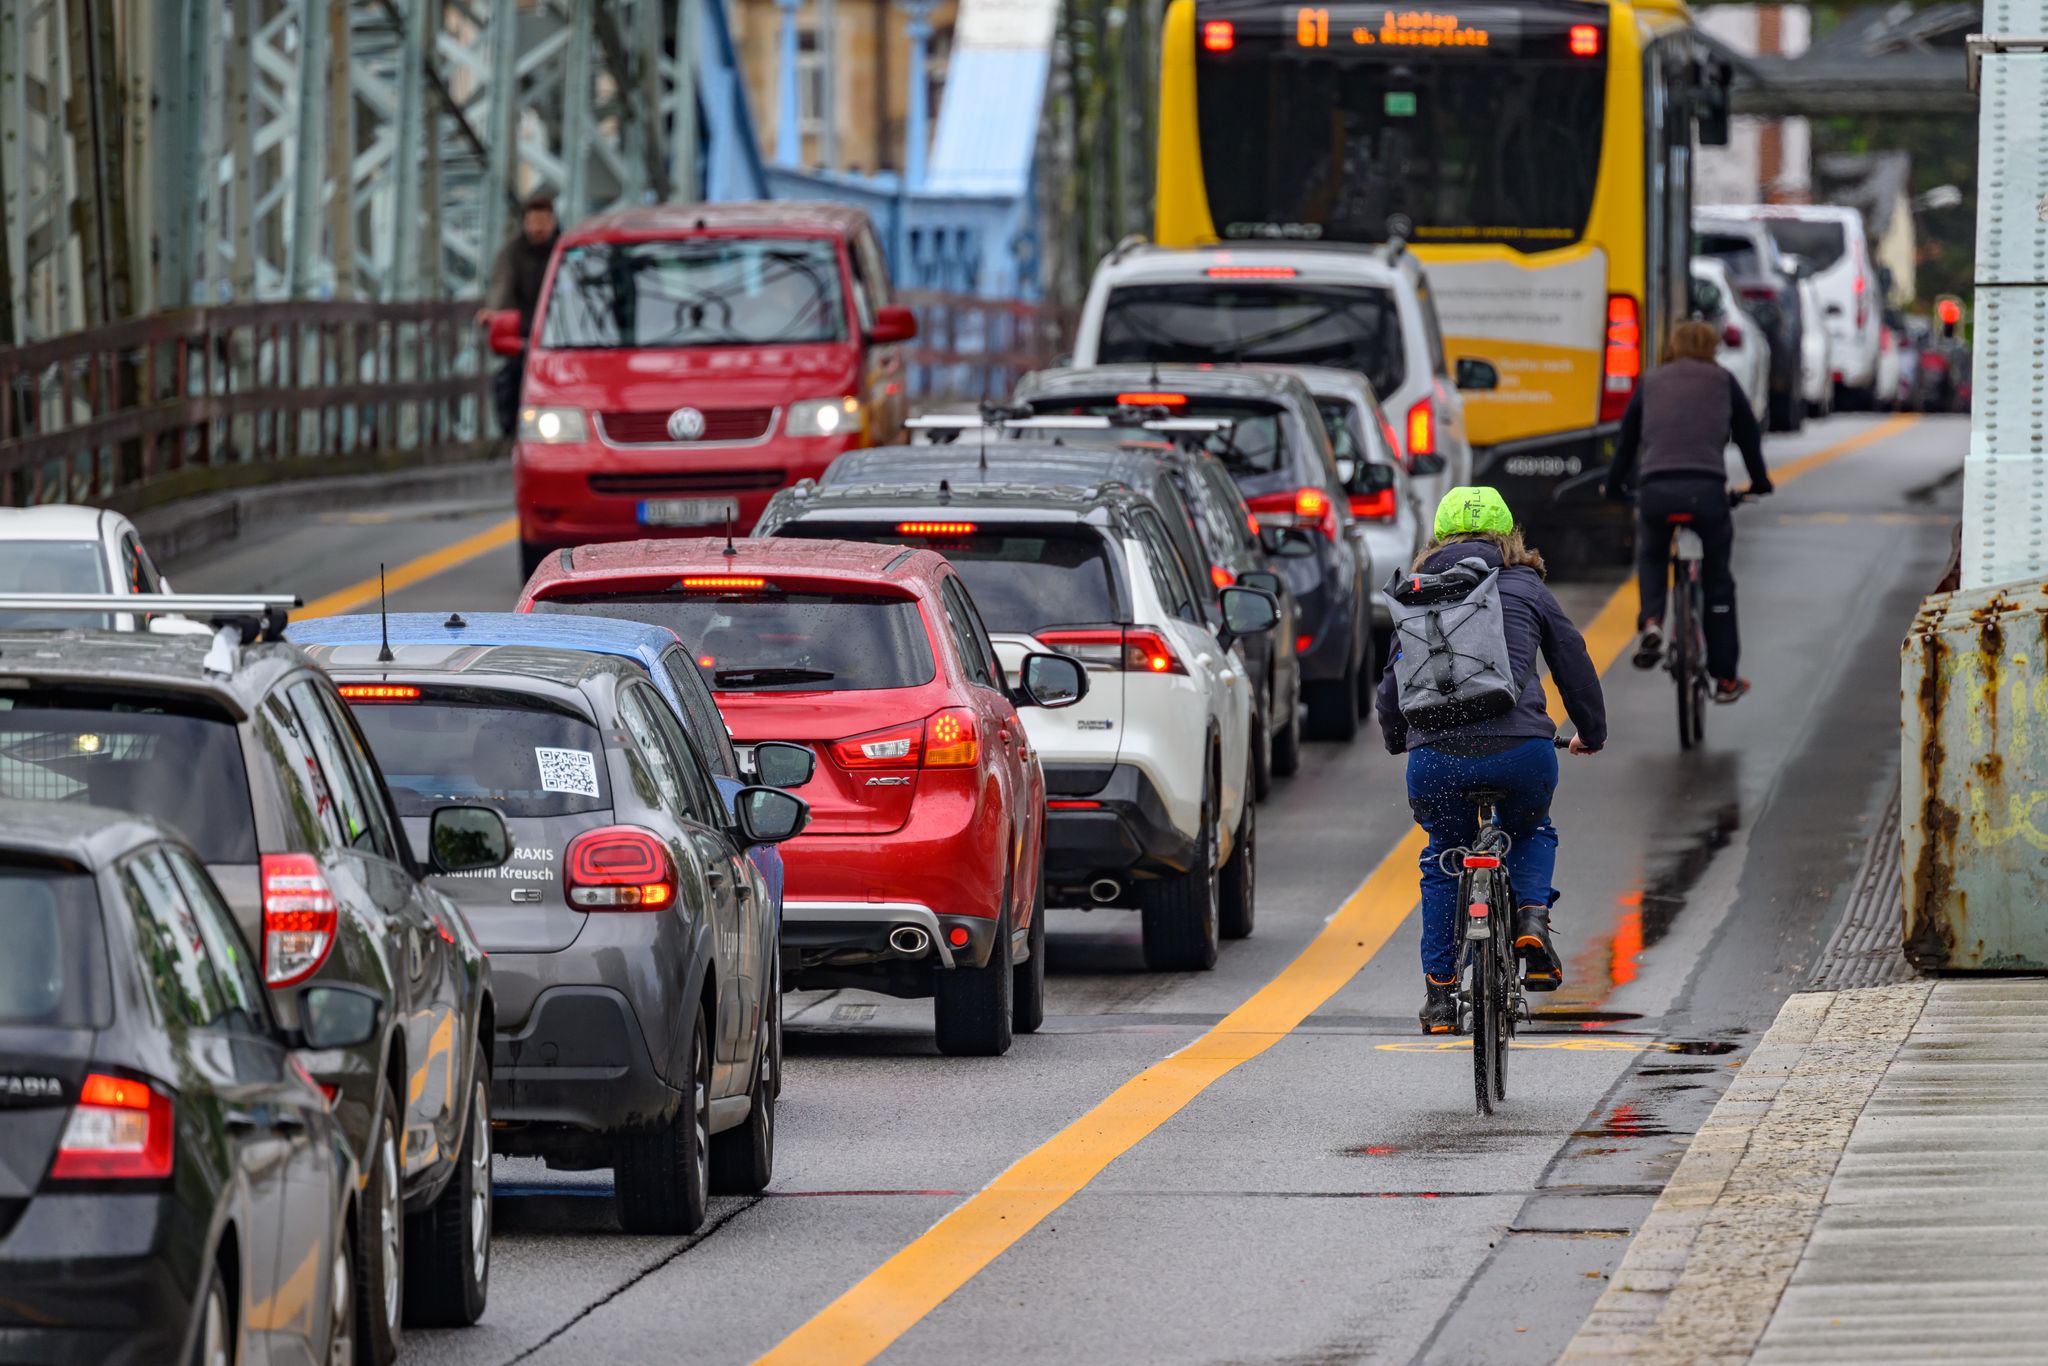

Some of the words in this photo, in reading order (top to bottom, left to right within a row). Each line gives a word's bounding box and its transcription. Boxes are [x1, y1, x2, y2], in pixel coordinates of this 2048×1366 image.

[1298, 7, 1329, 47] 61
[865, 776, 911, 786] ASX
[514, 848, 554, 860] RAXIS
[500, 866, 554, 880] Kreusch
[510, 888, 542, 902] C3
